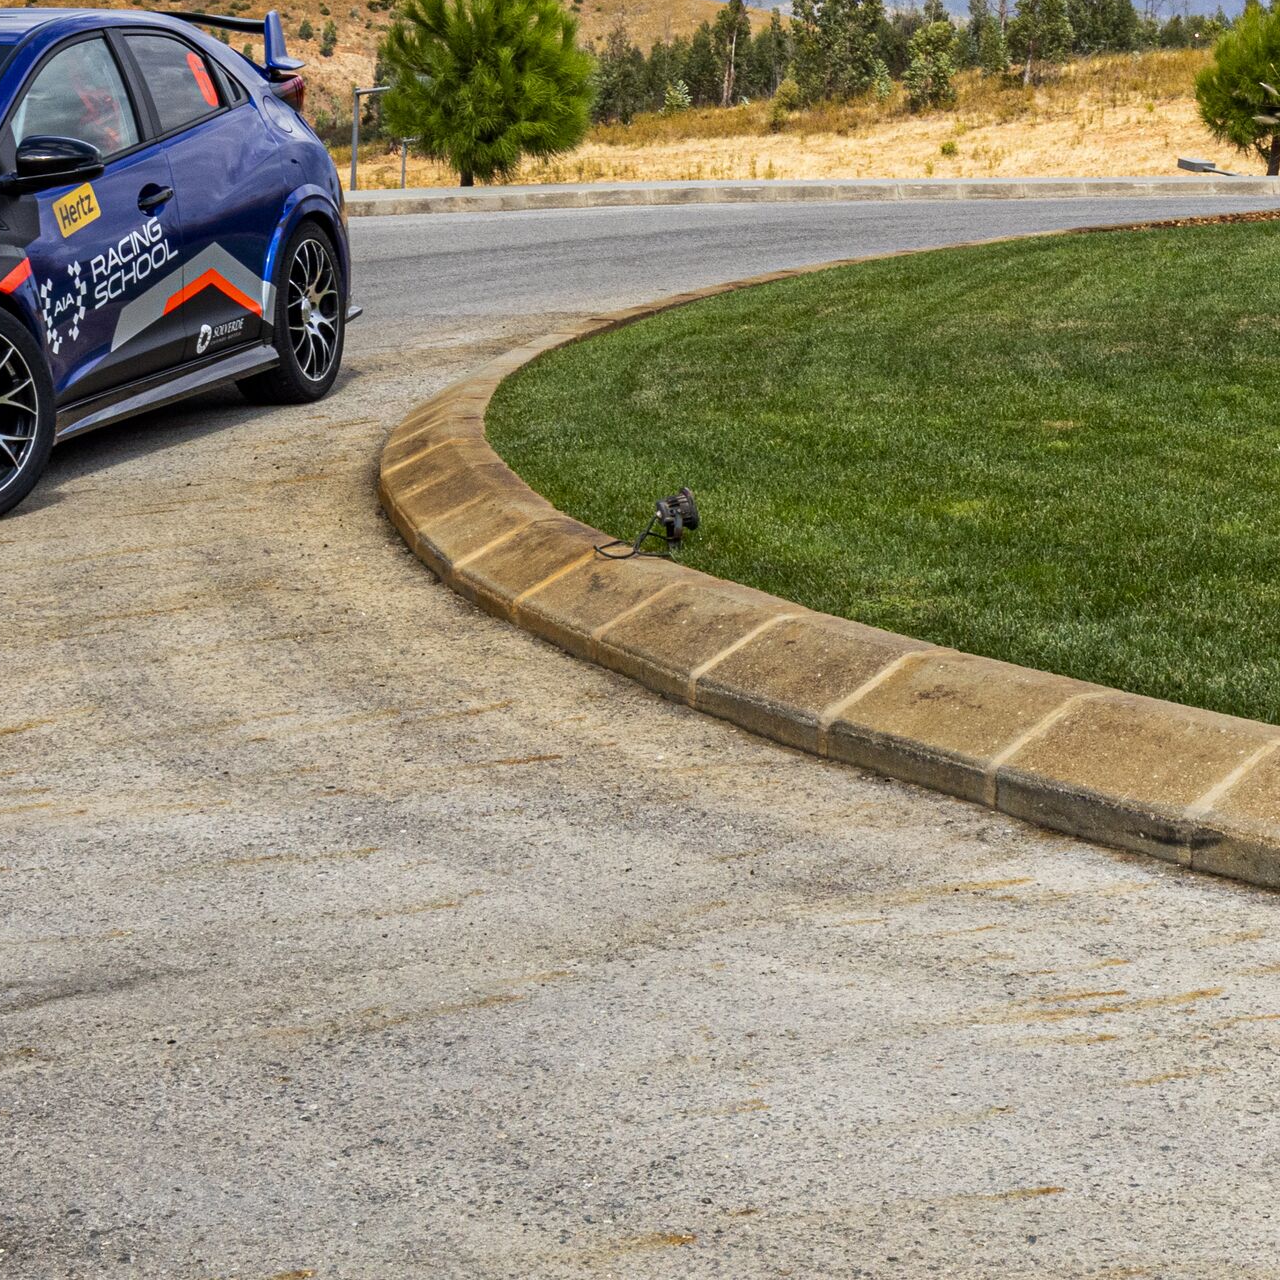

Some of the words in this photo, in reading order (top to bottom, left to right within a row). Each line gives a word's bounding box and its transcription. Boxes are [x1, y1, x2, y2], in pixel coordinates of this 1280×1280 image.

[186, 52, 219, 107] 6
[59, 194, 95, 230] Hertz
[90, 216, 162, 283] RACING
[94, 239, 179, 310] SCHOOL
[54, 293, 75, 317] AIA
